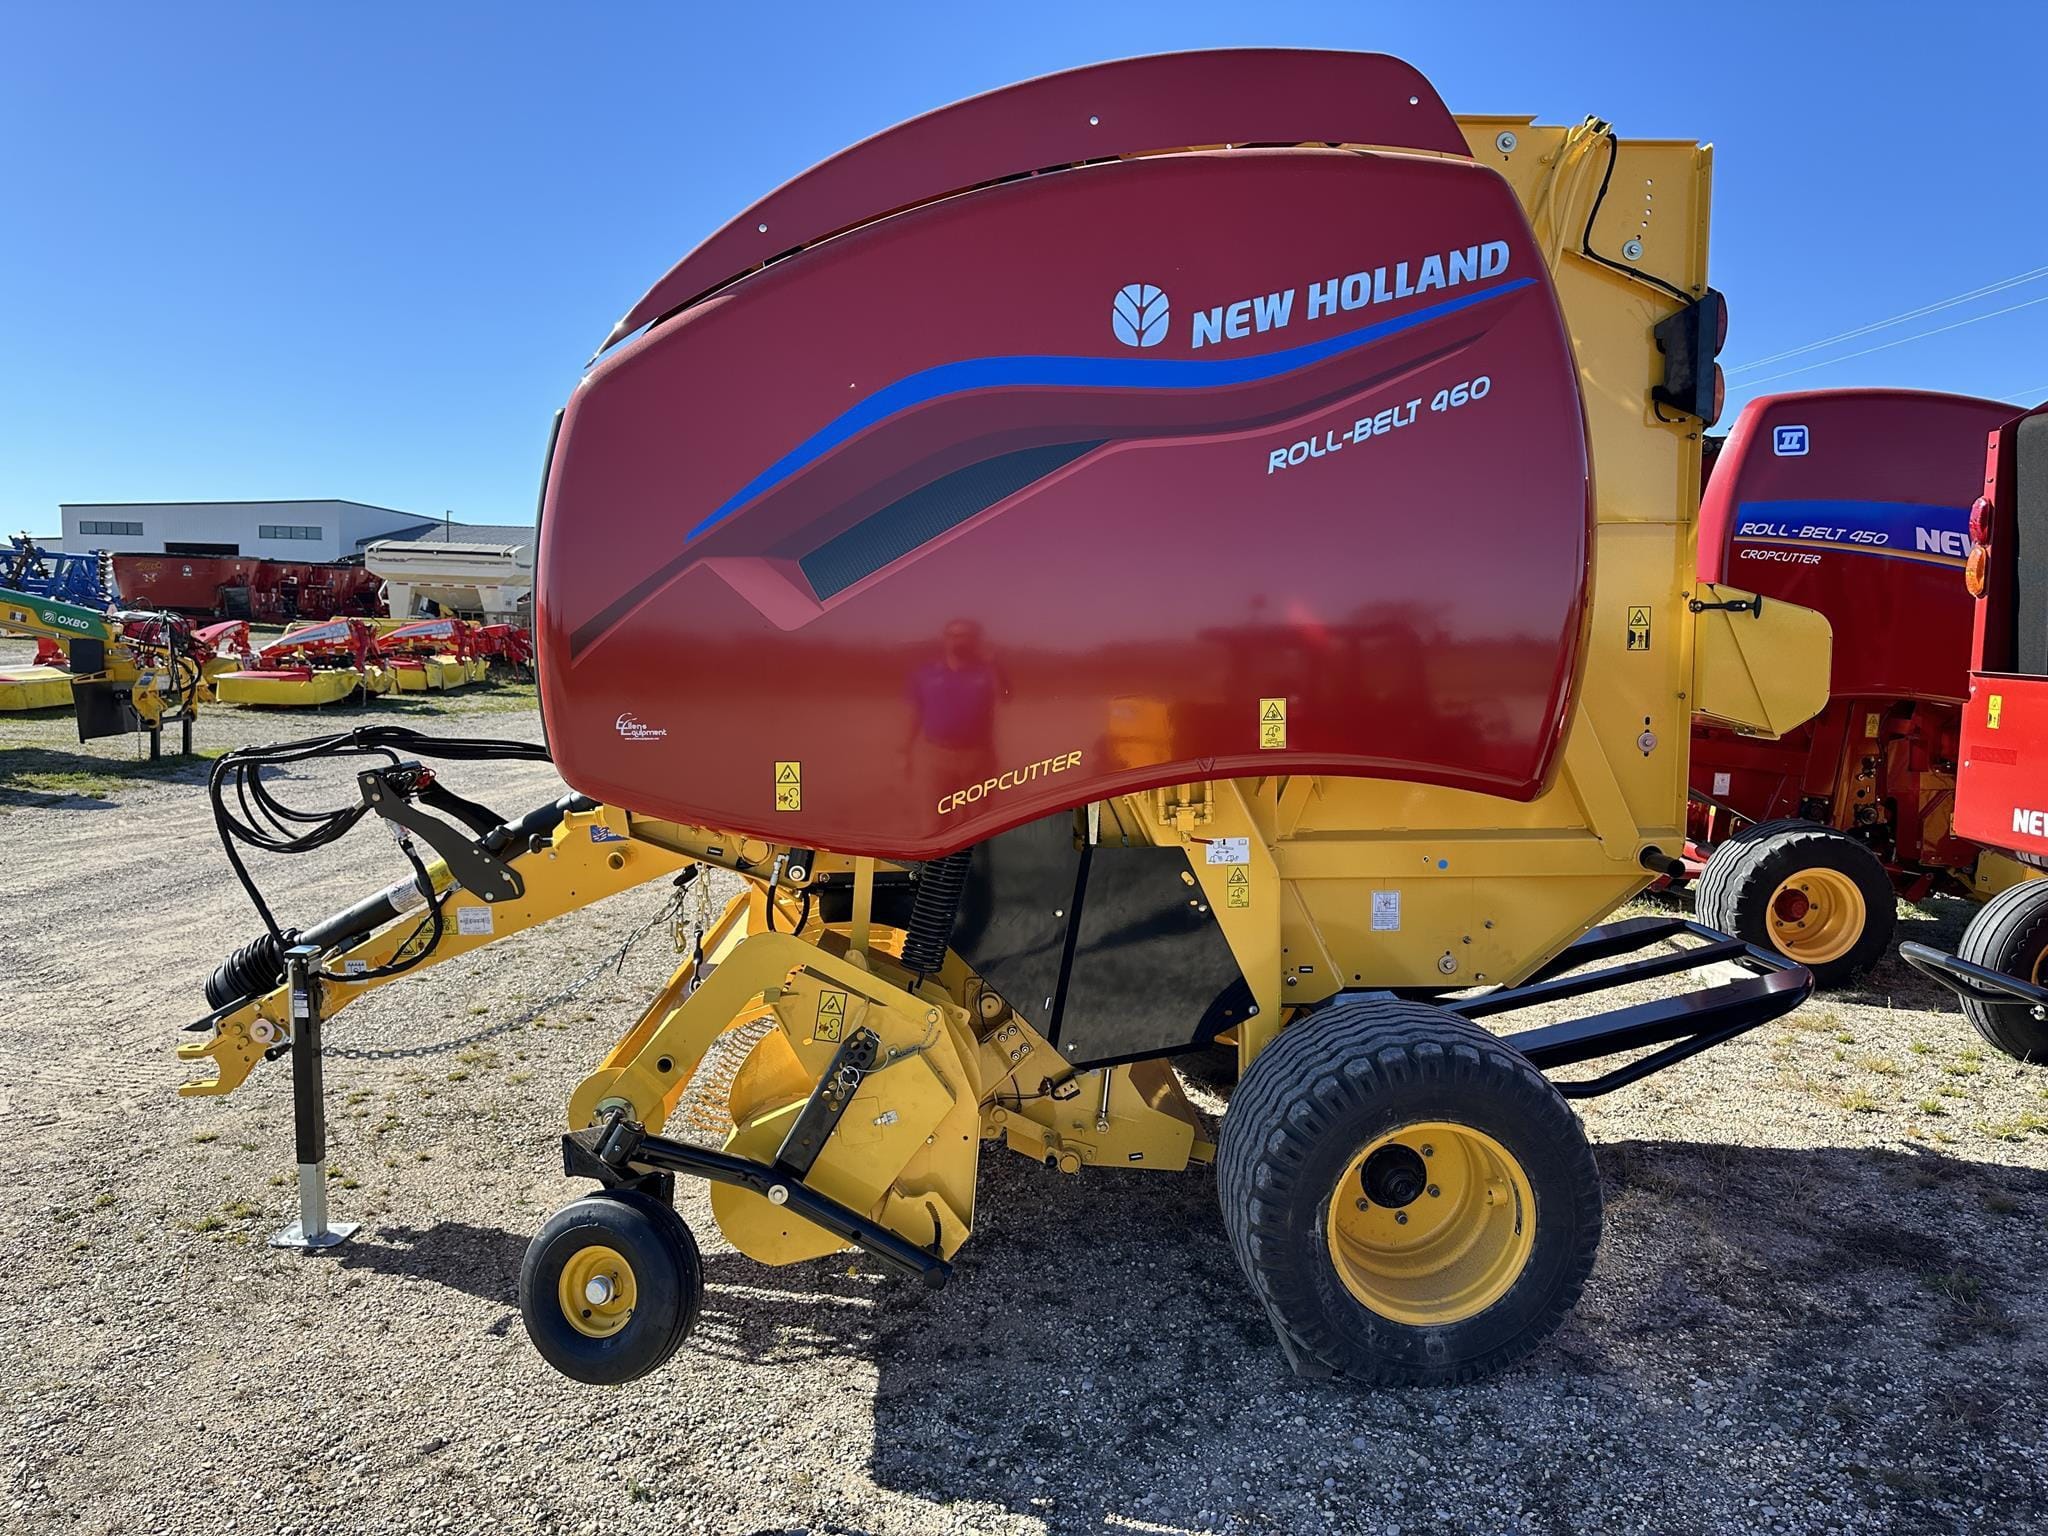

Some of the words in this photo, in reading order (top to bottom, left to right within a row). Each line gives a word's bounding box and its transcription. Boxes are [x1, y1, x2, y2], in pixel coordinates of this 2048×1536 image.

[1192, 289, 1295, 349] NEW
[1307, 240, 1510, 321] HOLLAND
[1268, 398, 1422, 474] ROLL-BELT
[1430, 375, 1491, 412] 460
[1739, 522, 1847, 541] ROLL-BELT
[1848, 530, 1889, 545] 450
[1740, 549, 1821, 565] CROPCUTTER
[57, 615, 89, 629] OXBO
[937, 750, 1083, 815] CROPCUTTER
[2012, 807, 2048, 838] NE
